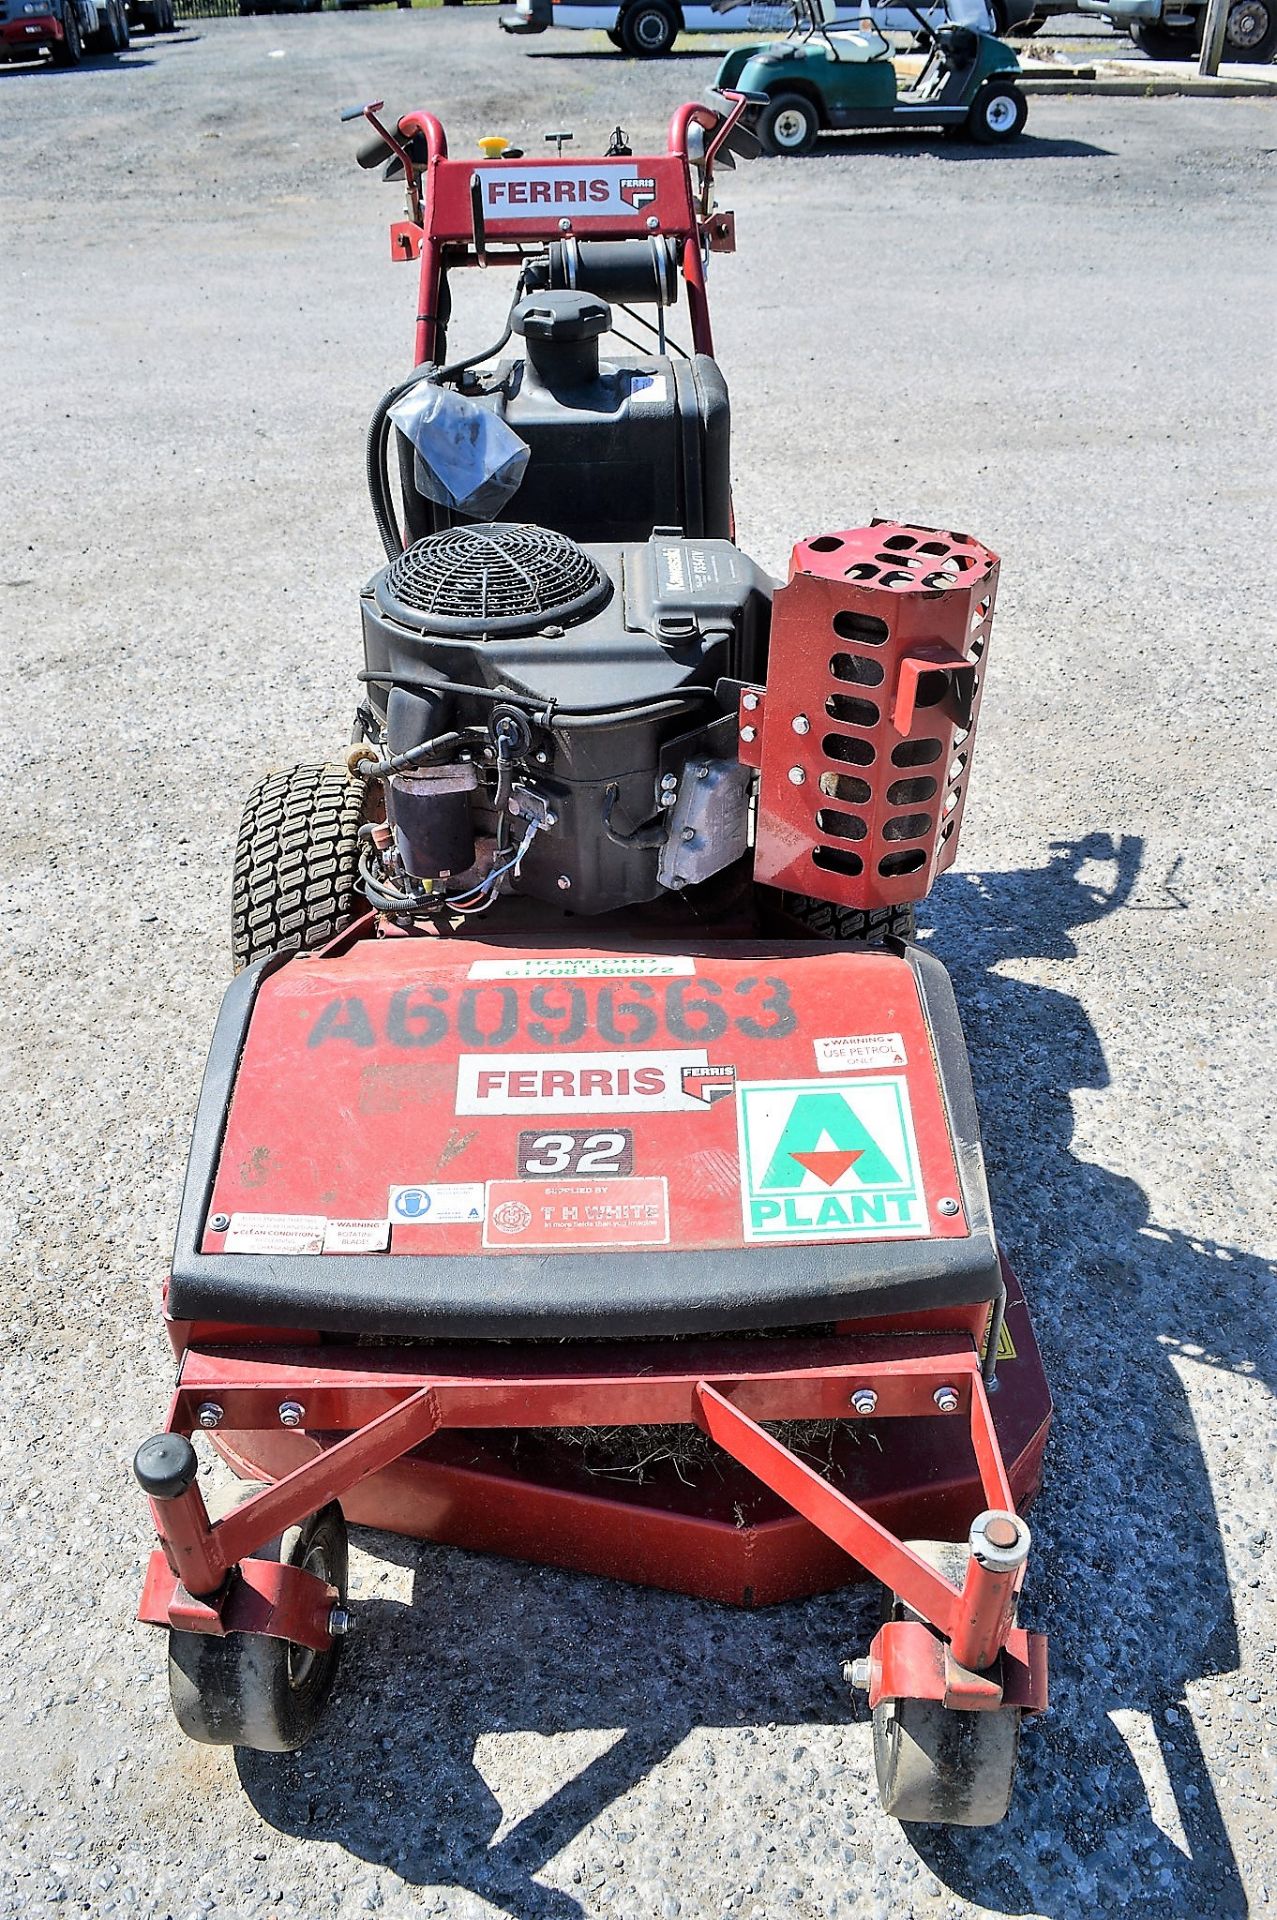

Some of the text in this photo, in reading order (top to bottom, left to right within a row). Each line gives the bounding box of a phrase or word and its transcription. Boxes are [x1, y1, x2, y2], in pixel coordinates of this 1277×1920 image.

[488, 179, 610, 205] FERRIS
[621, 179, 655, 188] FERRIS
[661, 547, 687, 592] Kawasaki
[305, 977, 799, 1049] A609663
[830, 1036, 886, 1046] WARNING
[823, 1044, 898, 1059] USE PETROL
[683, 1066, 734, 1078] FERRIS
[476, 1067, 667, 1099] FERRIS
[524, 1132, 627, 1174] 32
[544, 1186, 609, 1196] SUPPLIED BY
[540, 1205, 556, 1221] T
[562, 1205, 579, 1220] H
[584, 1203, 660, 1220] WHITE
[749, 1193, 918, 1228] PLANT
[240, 1228, 314, 1238] CLEAN CONDITION
